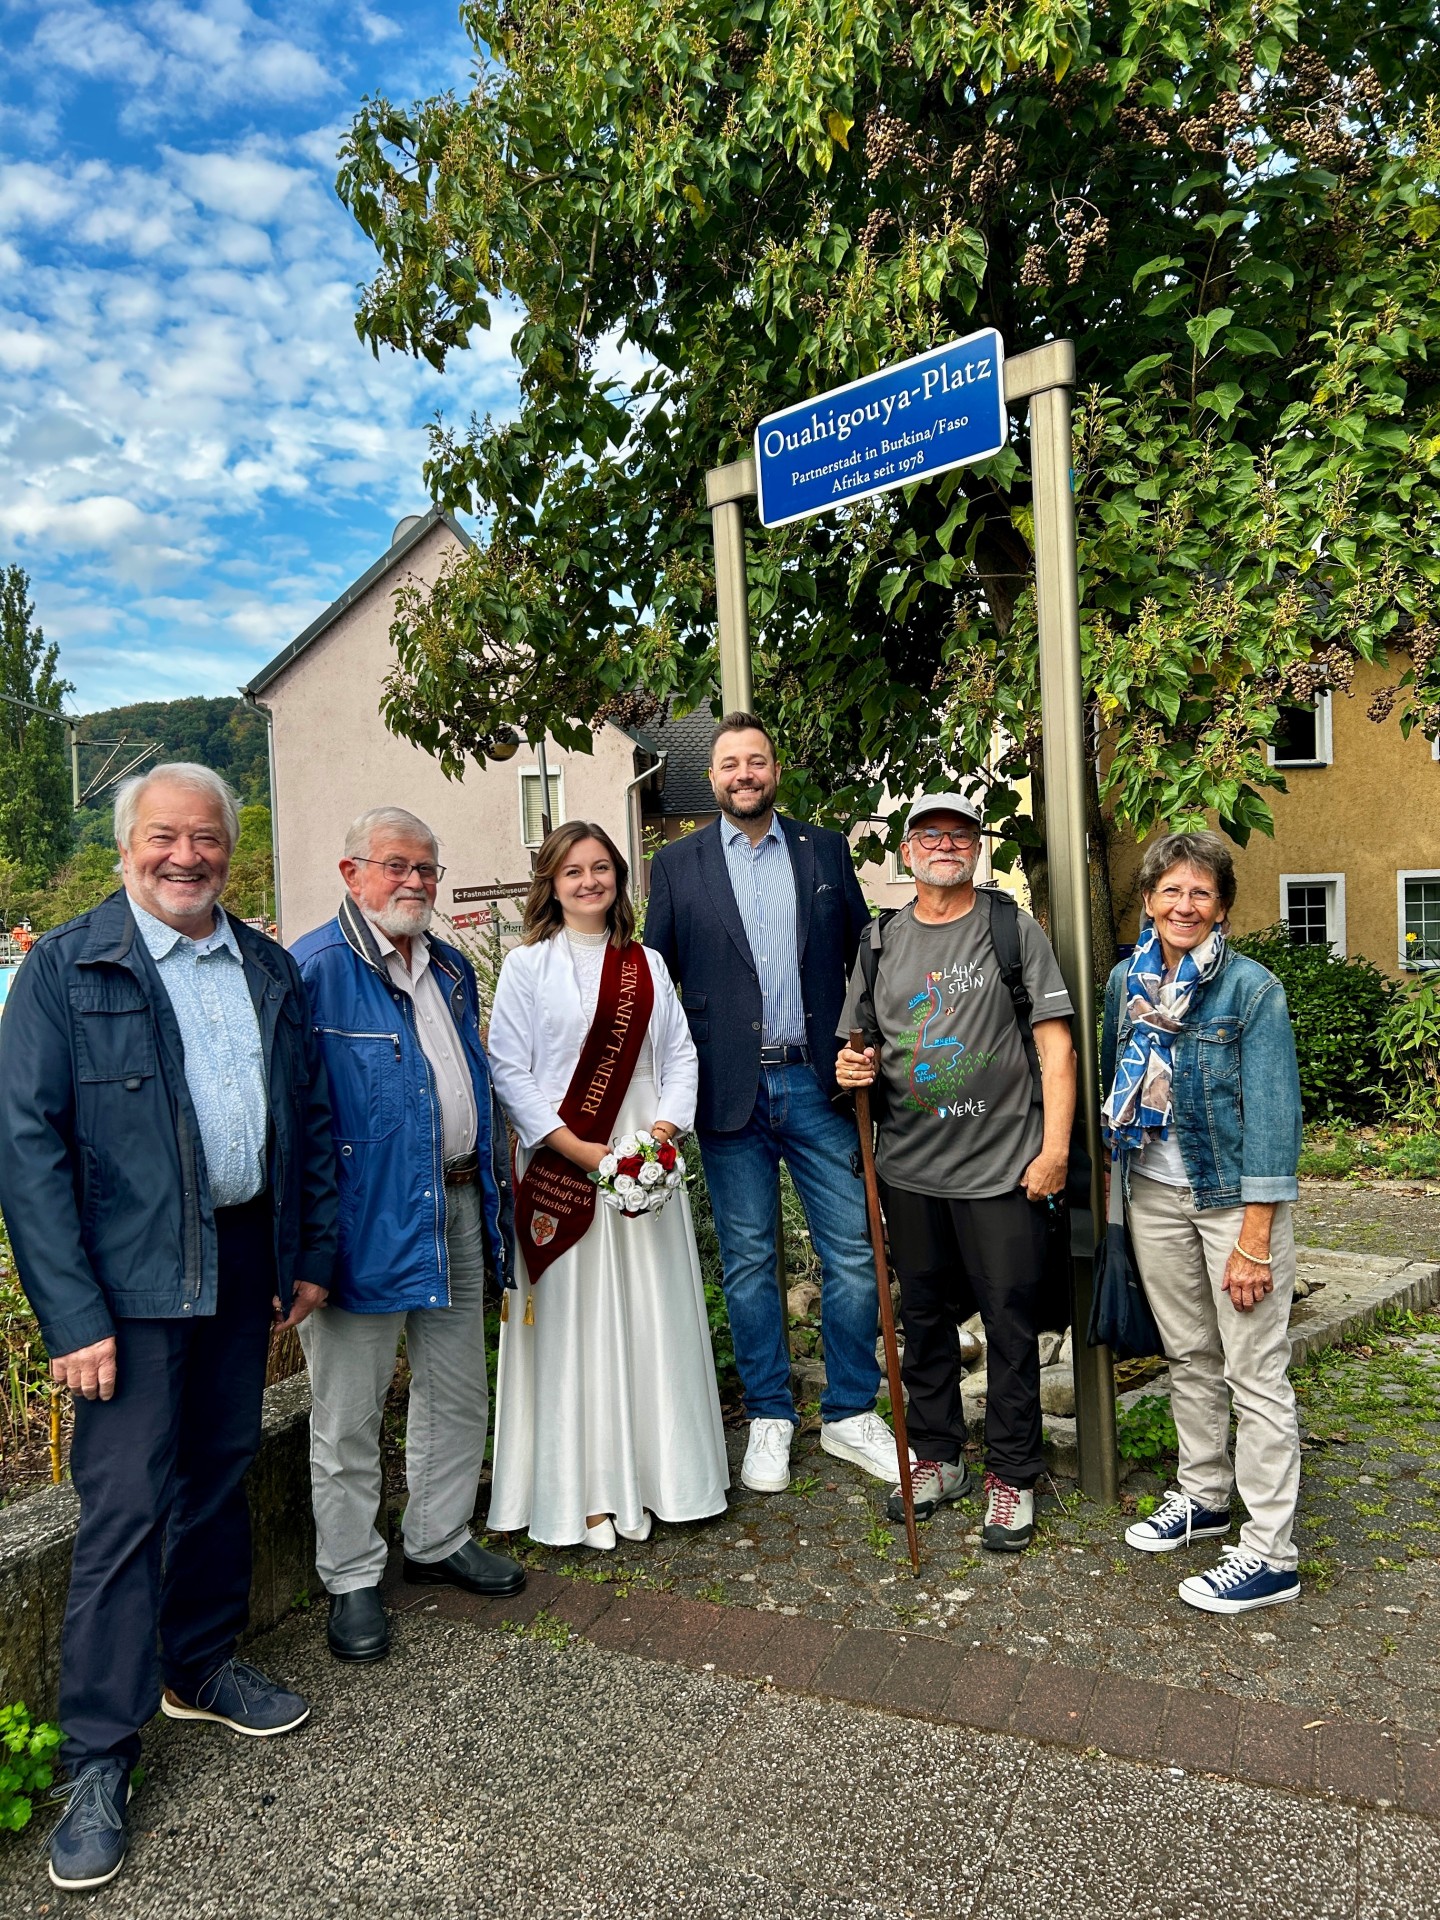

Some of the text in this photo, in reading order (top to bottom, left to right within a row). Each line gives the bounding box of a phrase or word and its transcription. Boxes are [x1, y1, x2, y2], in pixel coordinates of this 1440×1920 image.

[764, 358, 991, 458] Ouahigouya-Platz
[791, 415, 969, 486] Partnerstadt in Burkina/Faso
[831, 450, 925, 494] Afrika seit 1978
[943, 959, 983, 980] LAHN-
[948, 974, 985, 994] STEIN
[581, 961, 638, 1117] RHEIN-LAHN-NIXE
[935, 1036, 957, 1045] RHEIN
[947, 1098, 987, 1117] VENCE
[525, 1173, 574, 1201] Gesellschaft
[532, 1163, 593, 1193] Lehner Kirmes
[532, 1191, 572, 1215] Lahnstein
